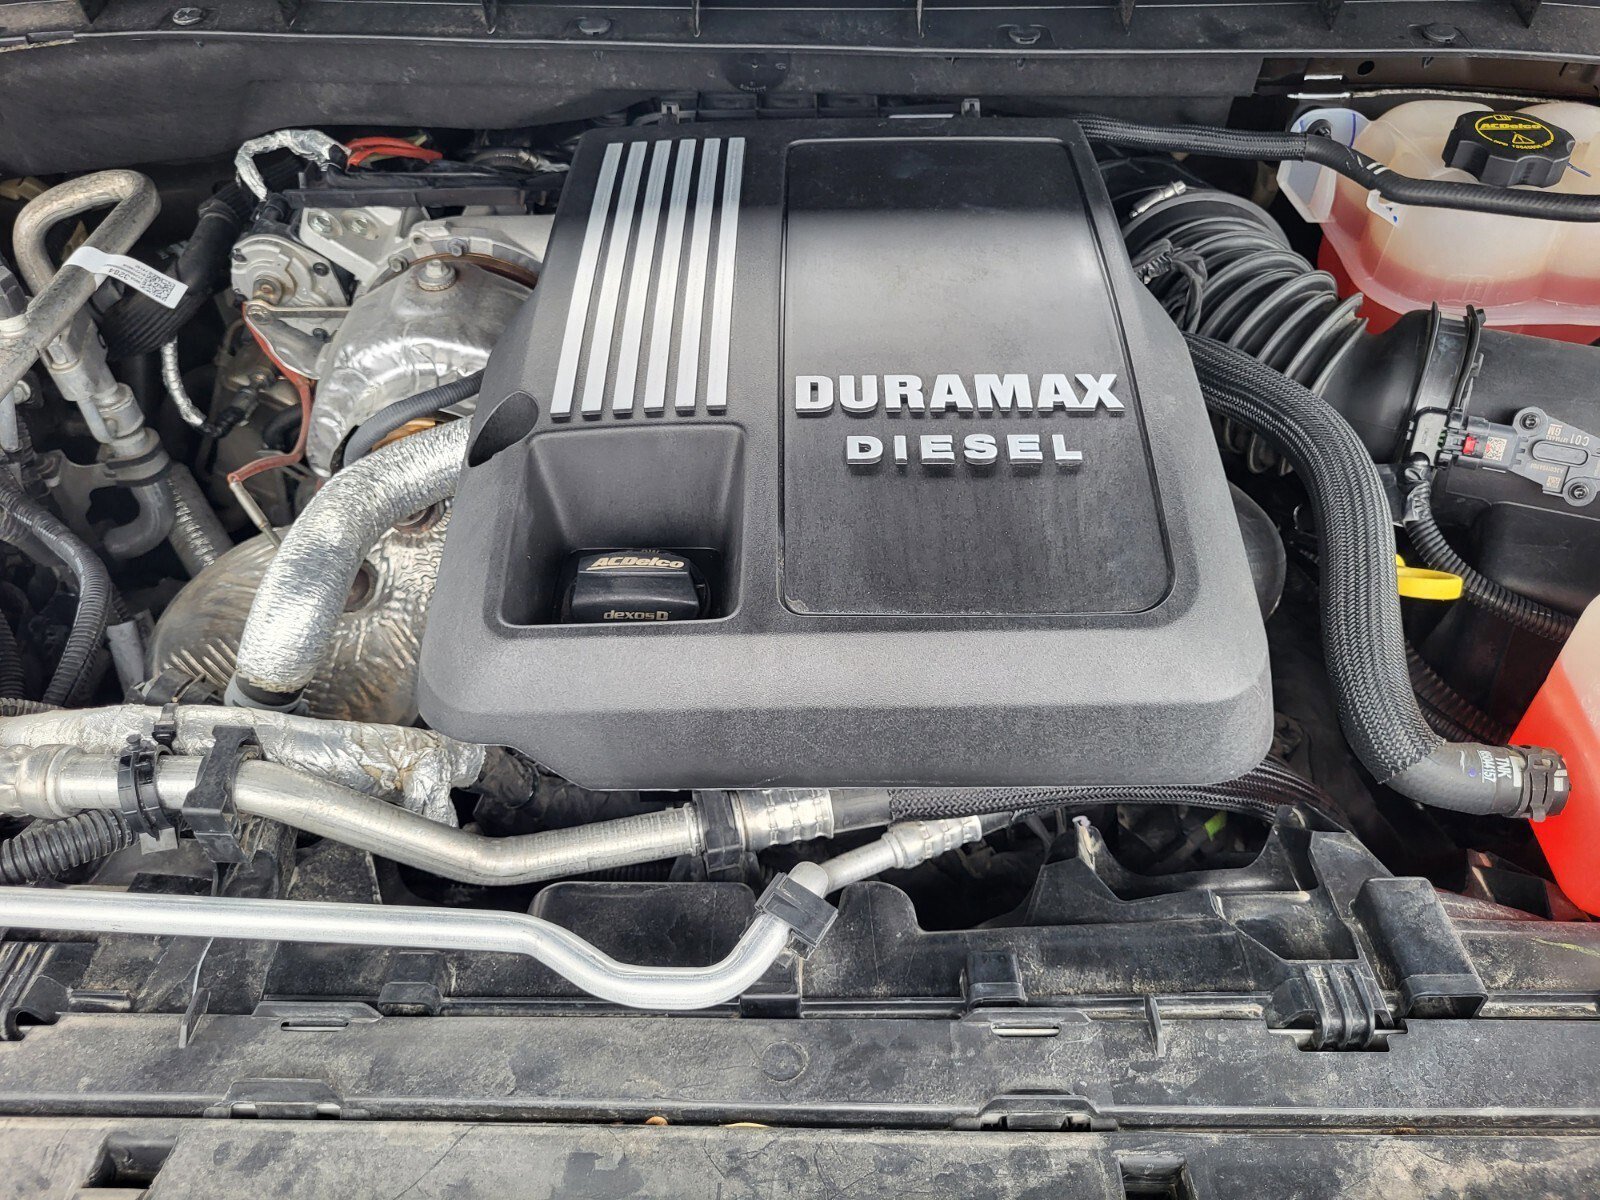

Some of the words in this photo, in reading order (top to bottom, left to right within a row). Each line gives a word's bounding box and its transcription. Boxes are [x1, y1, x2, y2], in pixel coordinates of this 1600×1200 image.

[795, 373, 1125, 413] DURAMAX
[846, 434, 1083, 465] DIESEL
[590, 556, 685, 569] ACDelco
[1495, 757, 1512, 779] TNK
